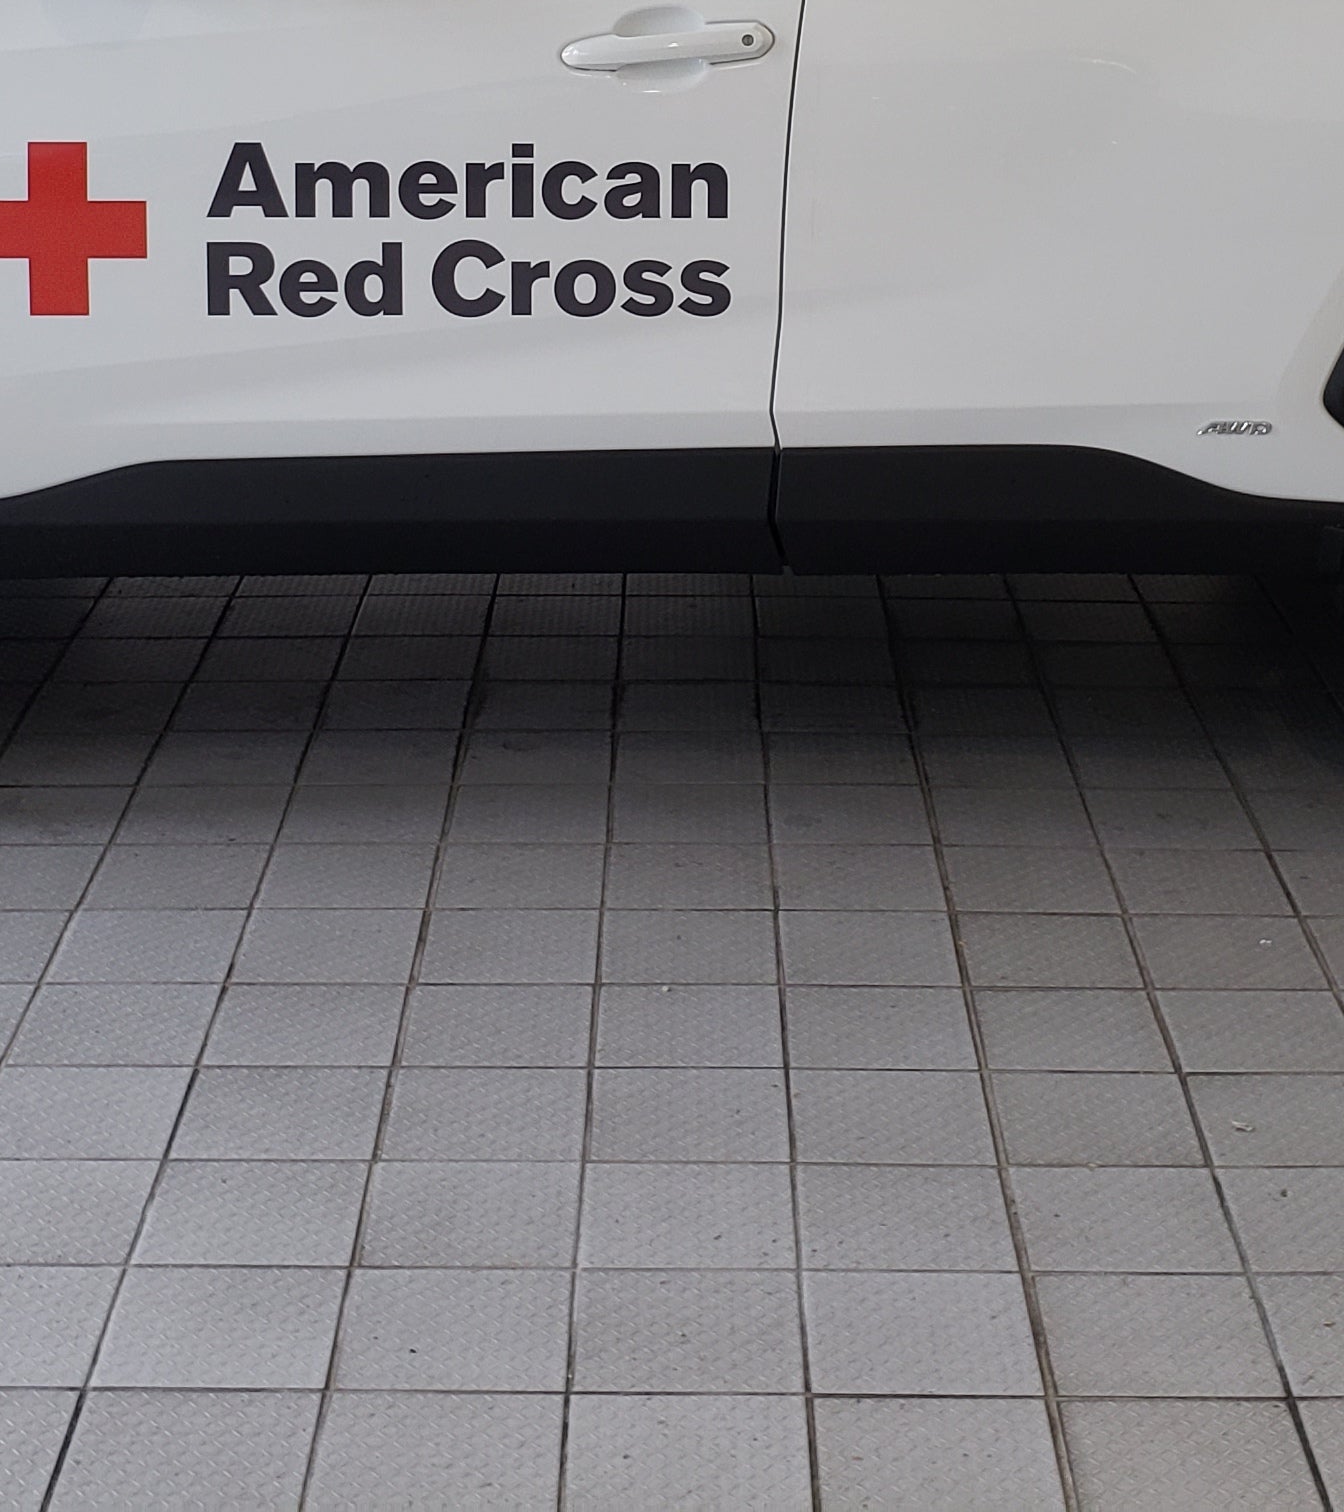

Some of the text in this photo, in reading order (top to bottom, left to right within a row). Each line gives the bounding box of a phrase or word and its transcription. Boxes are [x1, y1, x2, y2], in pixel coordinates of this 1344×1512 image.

[207, 141, 731, 221] American
[207, 239, 732, 319] Red Cross
